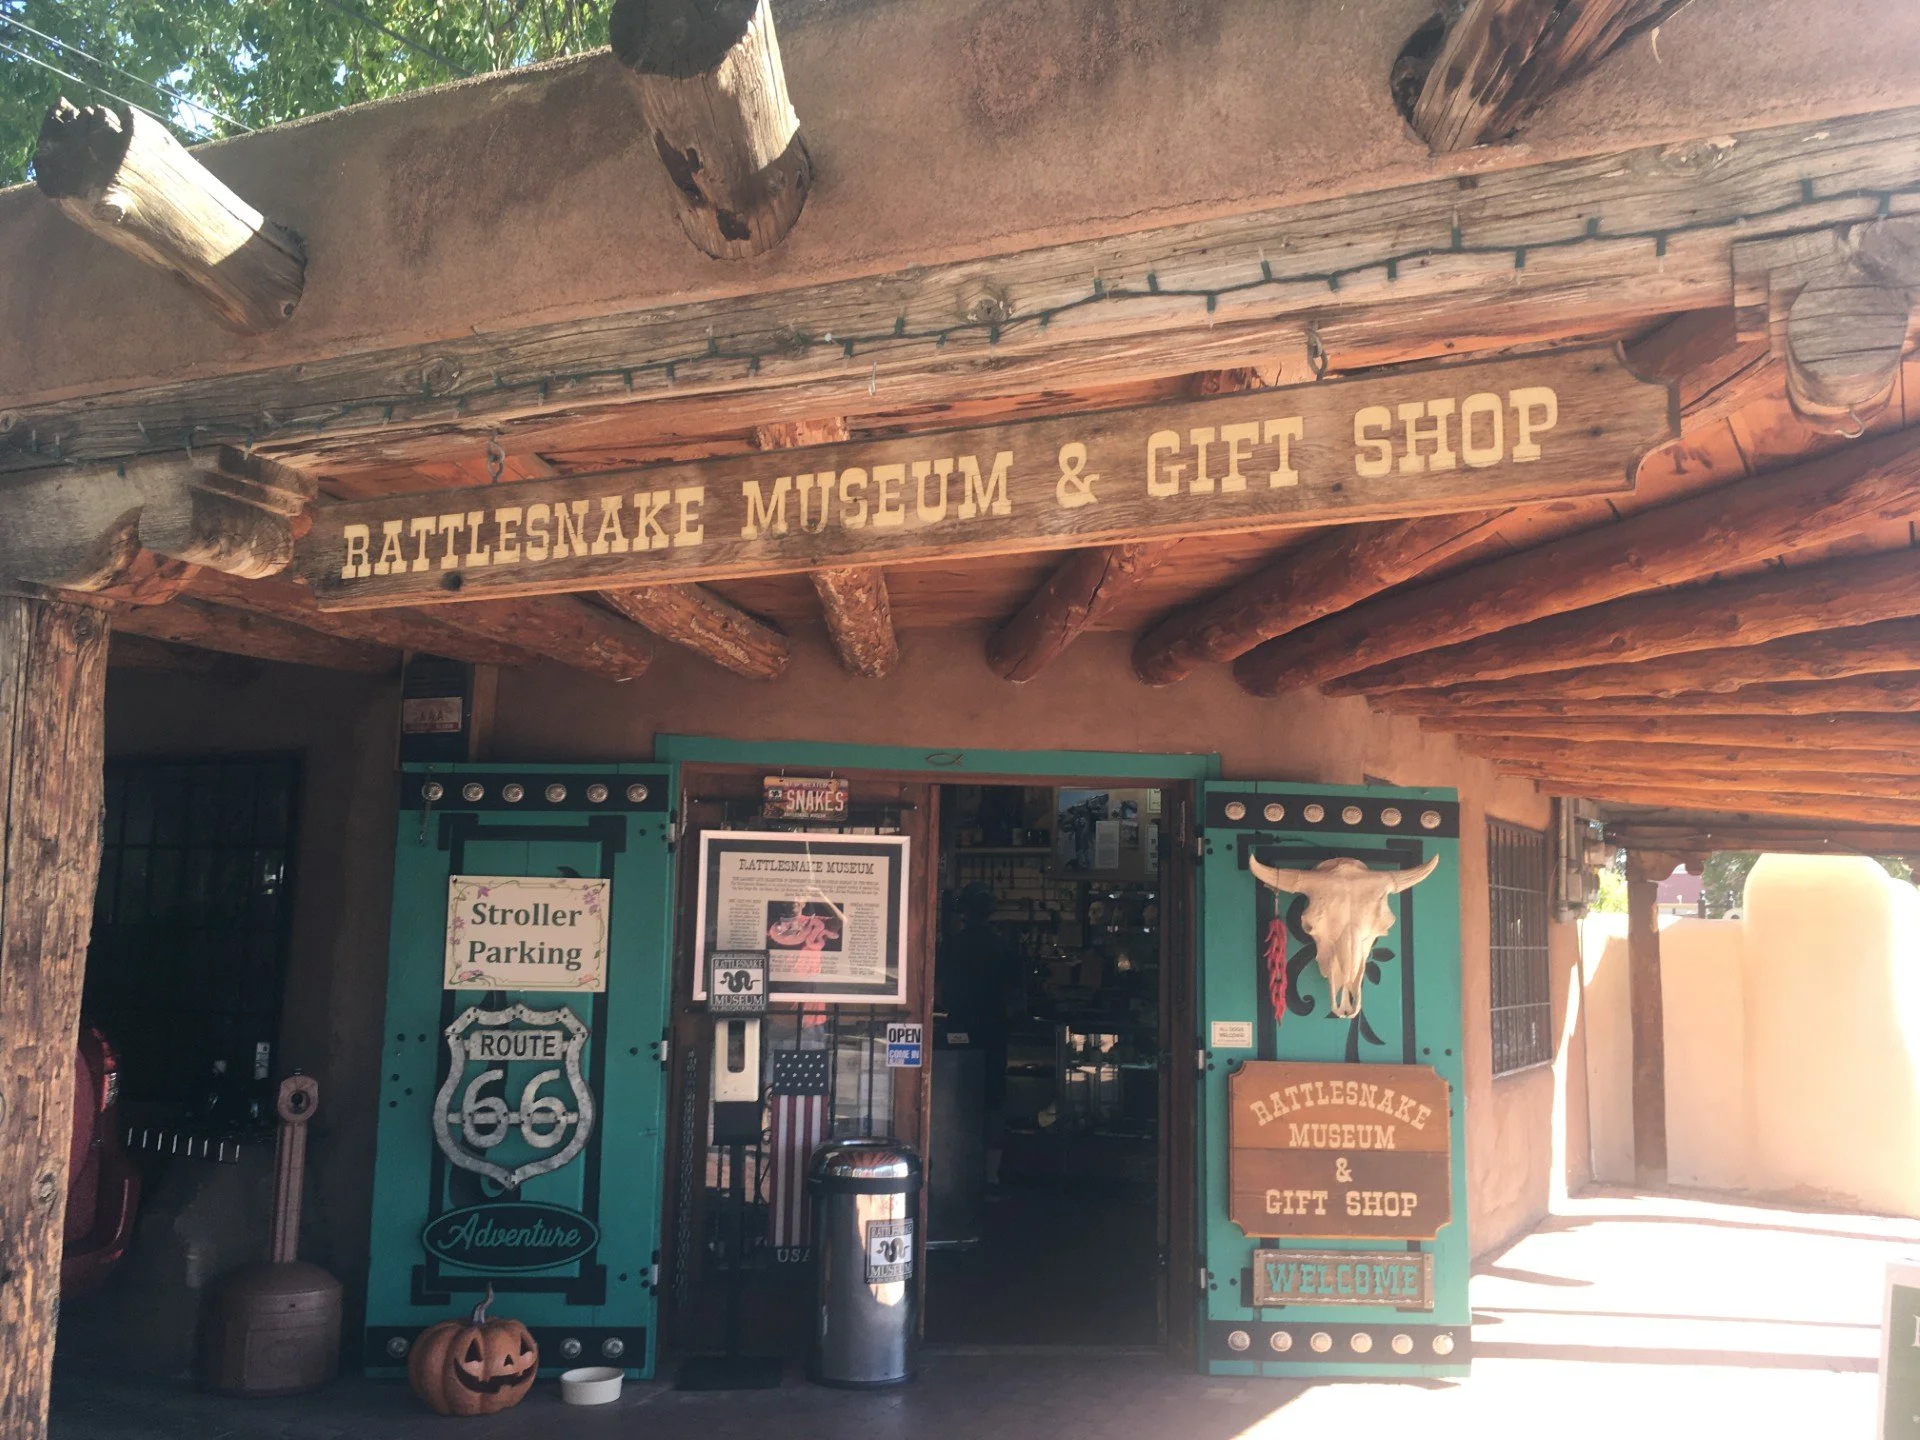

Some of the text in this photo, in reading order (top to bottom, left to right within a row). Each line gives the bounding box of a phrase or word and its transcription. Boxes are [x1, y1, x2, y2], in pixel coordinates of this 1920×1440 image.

[341, 386, 1558, 579] RATTLESNAKE MUSEUM & GIFT SHOP
[786, 790, 844, 811] SNAKES
[739, 858, 875, 875] RATTLESNAKE MUSEUM
[470, 902, 582, 927] Stroller
[467, 940, 582, 970] Parking
[714, 995, 764, 1005] MUSEUM
[480, 1034, 556, 1057] ROUTE
[888, 1028, 921, 1043] OPEN
[461, 1068, 568, 1149] 66
[1249, 1080, 1432, 1131] RATTLESNAKE
[1288, 1123, 1396, 1150] MUSEUM
[1335, 1157, 1353, 1183] &
[1265, 1189, 1418, 1217] GIFT SHOP
[437, 1212, 581, 1251] Adventure
[1265, 1262, 1420, 1296] WELCOME
